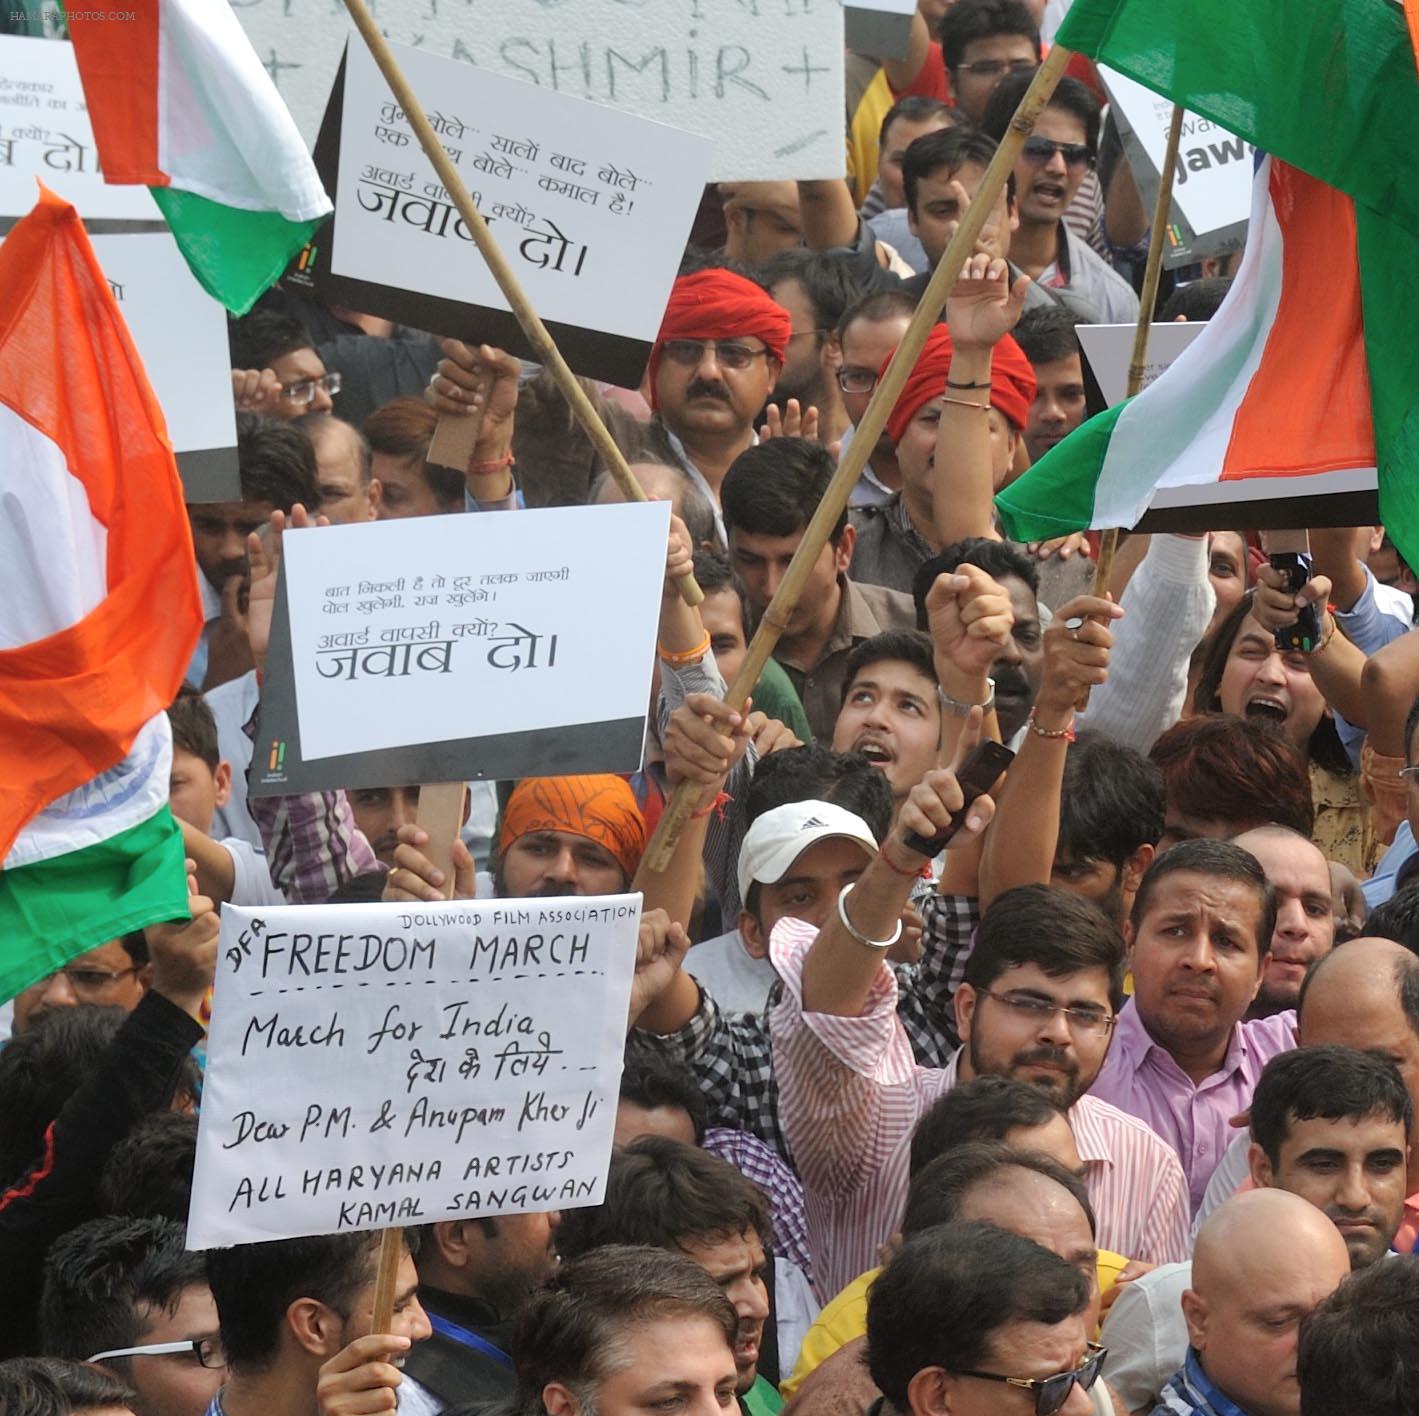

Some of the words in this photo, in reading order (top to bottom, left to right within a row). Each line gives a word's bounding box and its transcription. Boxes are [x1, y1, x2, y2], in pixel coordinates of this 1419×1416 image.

[537, 174, 600, 205] कमाल
[316, 640, 458, 680] जवाब
[487, 623, 558, 672] दो।
[318, 628, 369, 649] अवार्ड
[381, 620, 439, 642] वापसी
[397, 914, 482, 929] DOLLYWOOD
[493, 911, 531, 926] FILM
[539, 906, 637, 926] ASSOCIATION
[225, 918, 267, 972] DFA
[262, 933, 435, 978] FREEDOM
[470, 933, 590, 973] MARCH
[241, 1013, 344, 1056] March
[368, 1004, 423, 1054] for
[439, 1001, 534, 1039] India
[407, 1048, 447, 1093] देश
[223, 1110, 290, 1149] Dear
[301, 1104, 356, 1142] P.M.
[370, 1100, 395, 1133] &
[404, 1096, 506, 1144] Anupam
[517, 1091, 570, 1132] Kher
[229, 1177, 287, 1212] ALL
[302, 1160, 442, 1195] HARYANA
[464, 1150, 575, 1180] ARTISTS
[338, 1197, 425, 1229] KAMAL
[446, 1177, 598, 1210] SANGWAN
